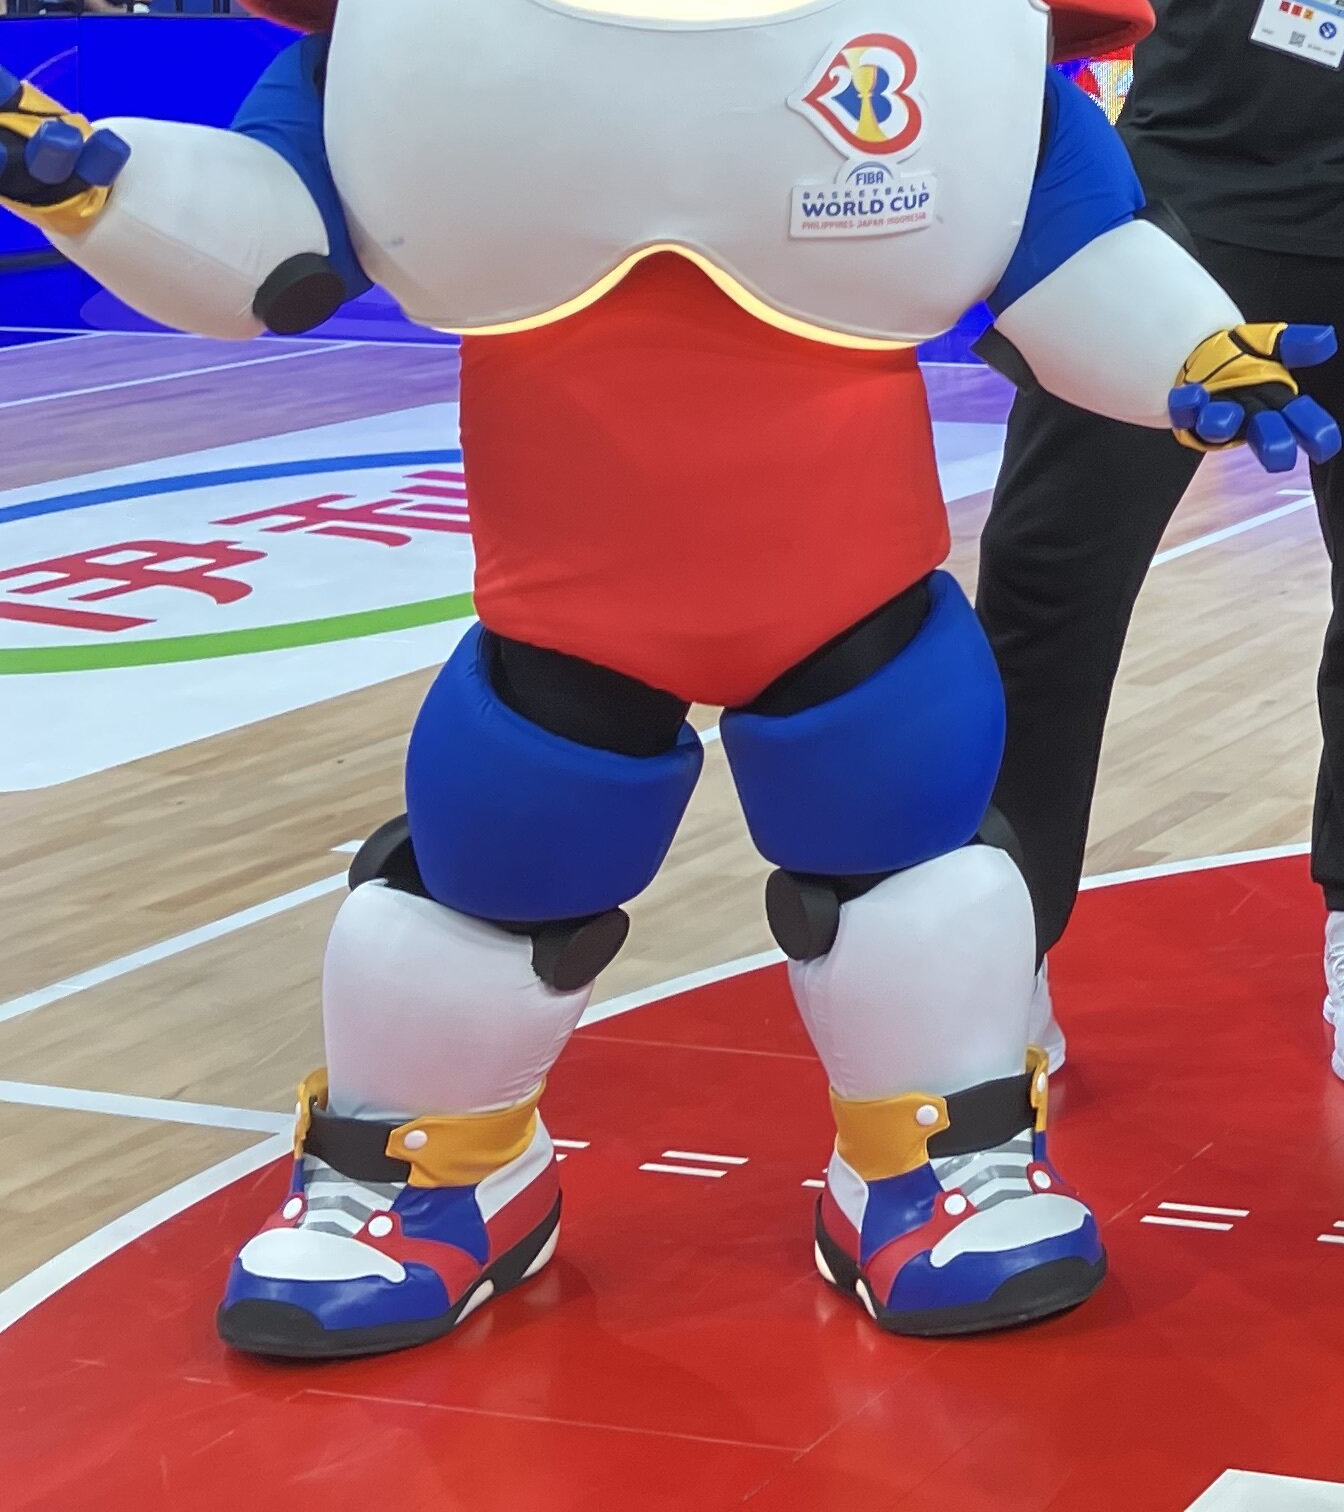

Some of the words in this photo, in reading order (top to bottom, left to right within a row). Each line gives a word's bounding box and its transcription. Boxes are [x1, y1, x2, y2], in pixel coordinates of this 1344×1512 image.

[856, 171, 884, 186] FIBA
[802, 181, 928, 201] BASKETBALL
[802, 198, 884, 218] WORLD
[889, 192, 931, 212] CUP
[802, 219, 854, 231] PHILIPPINES
[856, 218, 884, 230] JAPAN
[886, 211, 927, 226] INDONESIA
